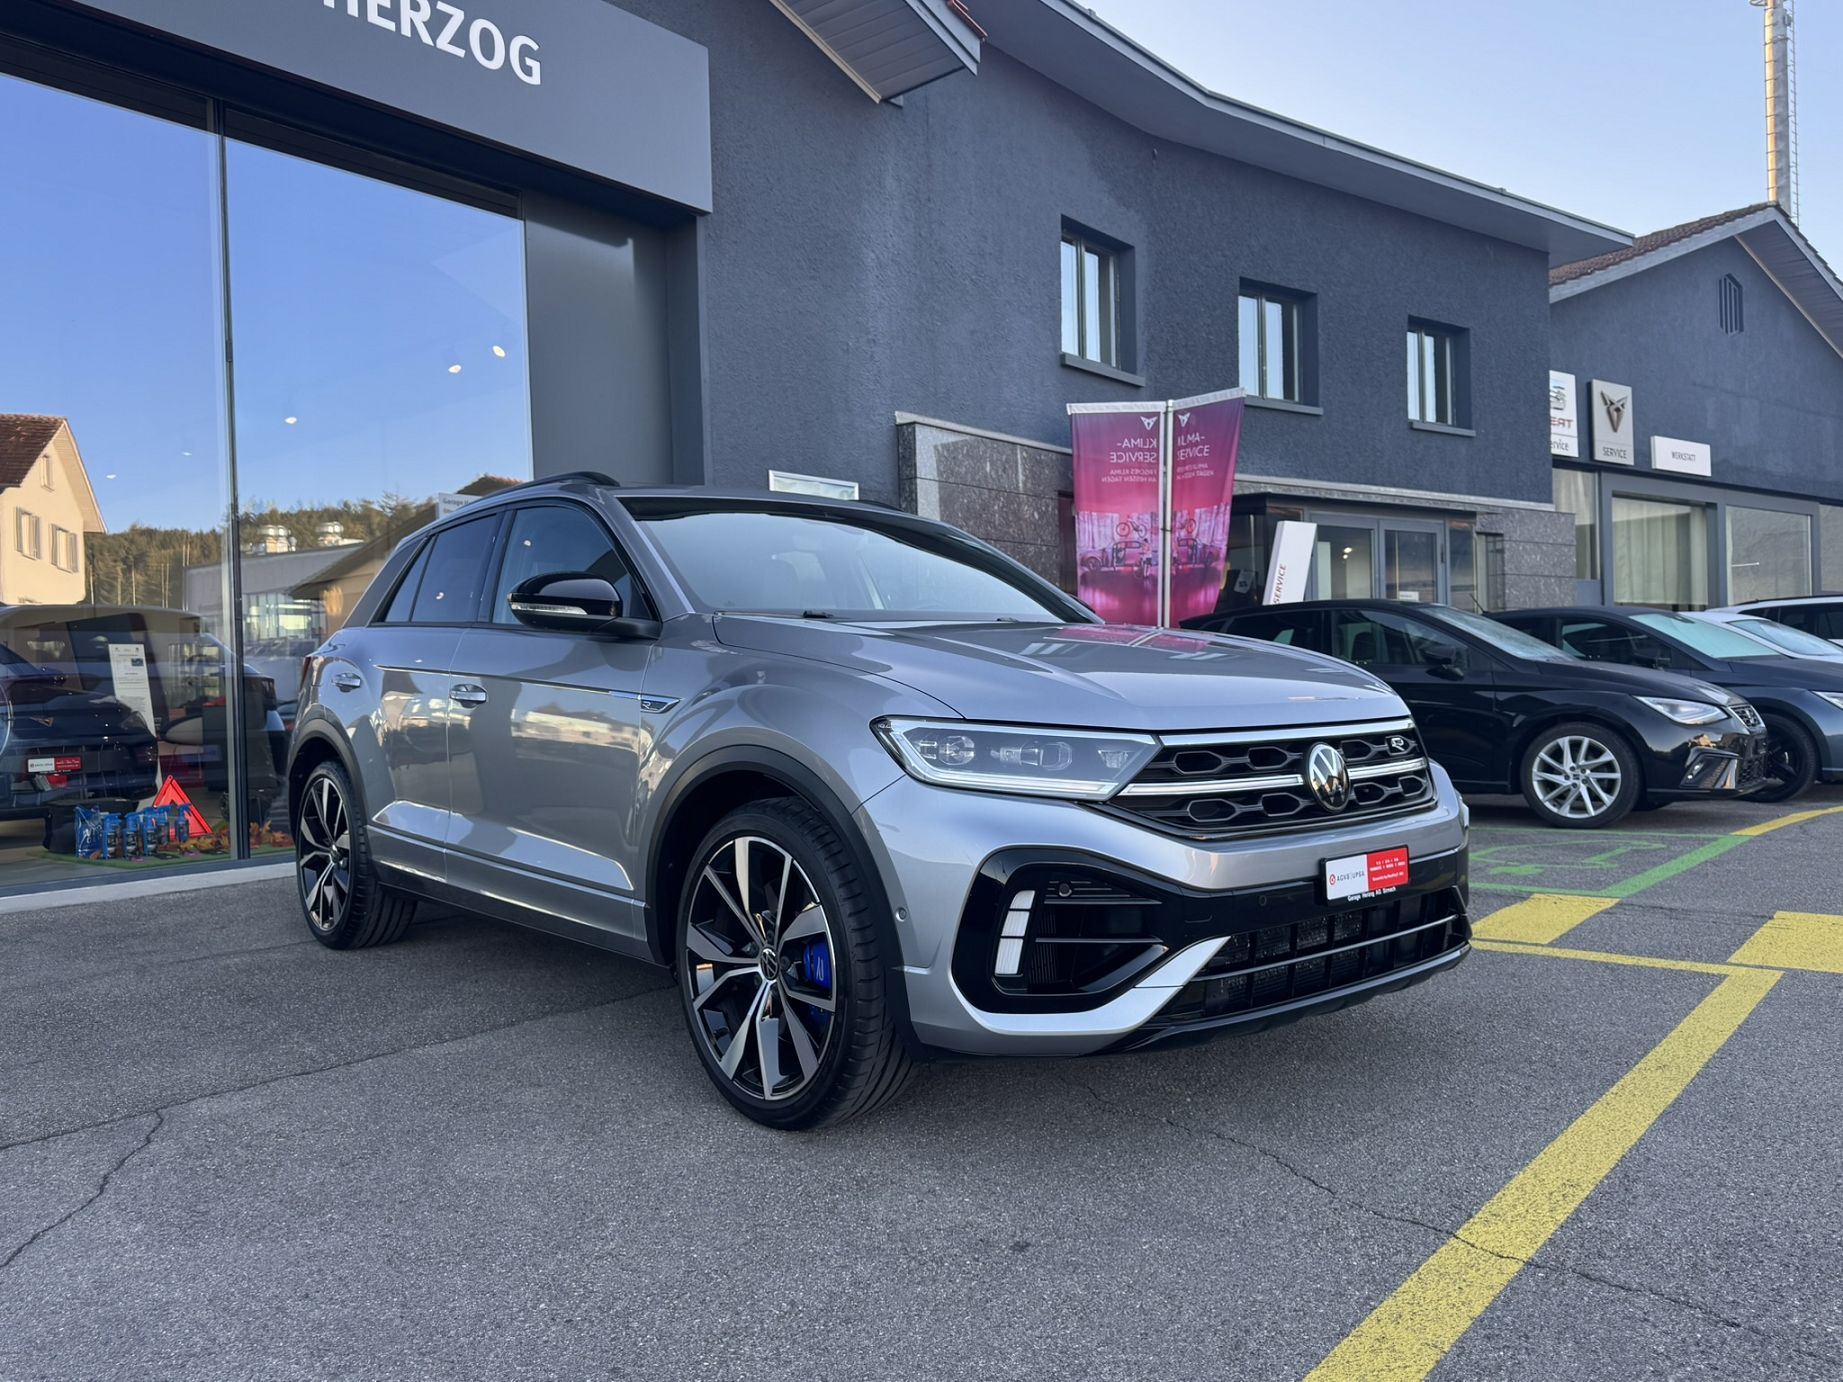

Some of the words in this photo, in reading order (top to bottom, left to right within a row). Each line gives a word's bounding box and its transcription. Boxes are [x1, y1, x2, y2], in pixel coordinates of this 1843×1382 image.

[323, 0, 541, 85] ERZOG
[1551, 416, 1573, 428] EAT
[1602, 446, 1627, 459] SERVICE
[1273, 564, 1286, 604] SERVICE
[1391, 738, 1405, 751] R
